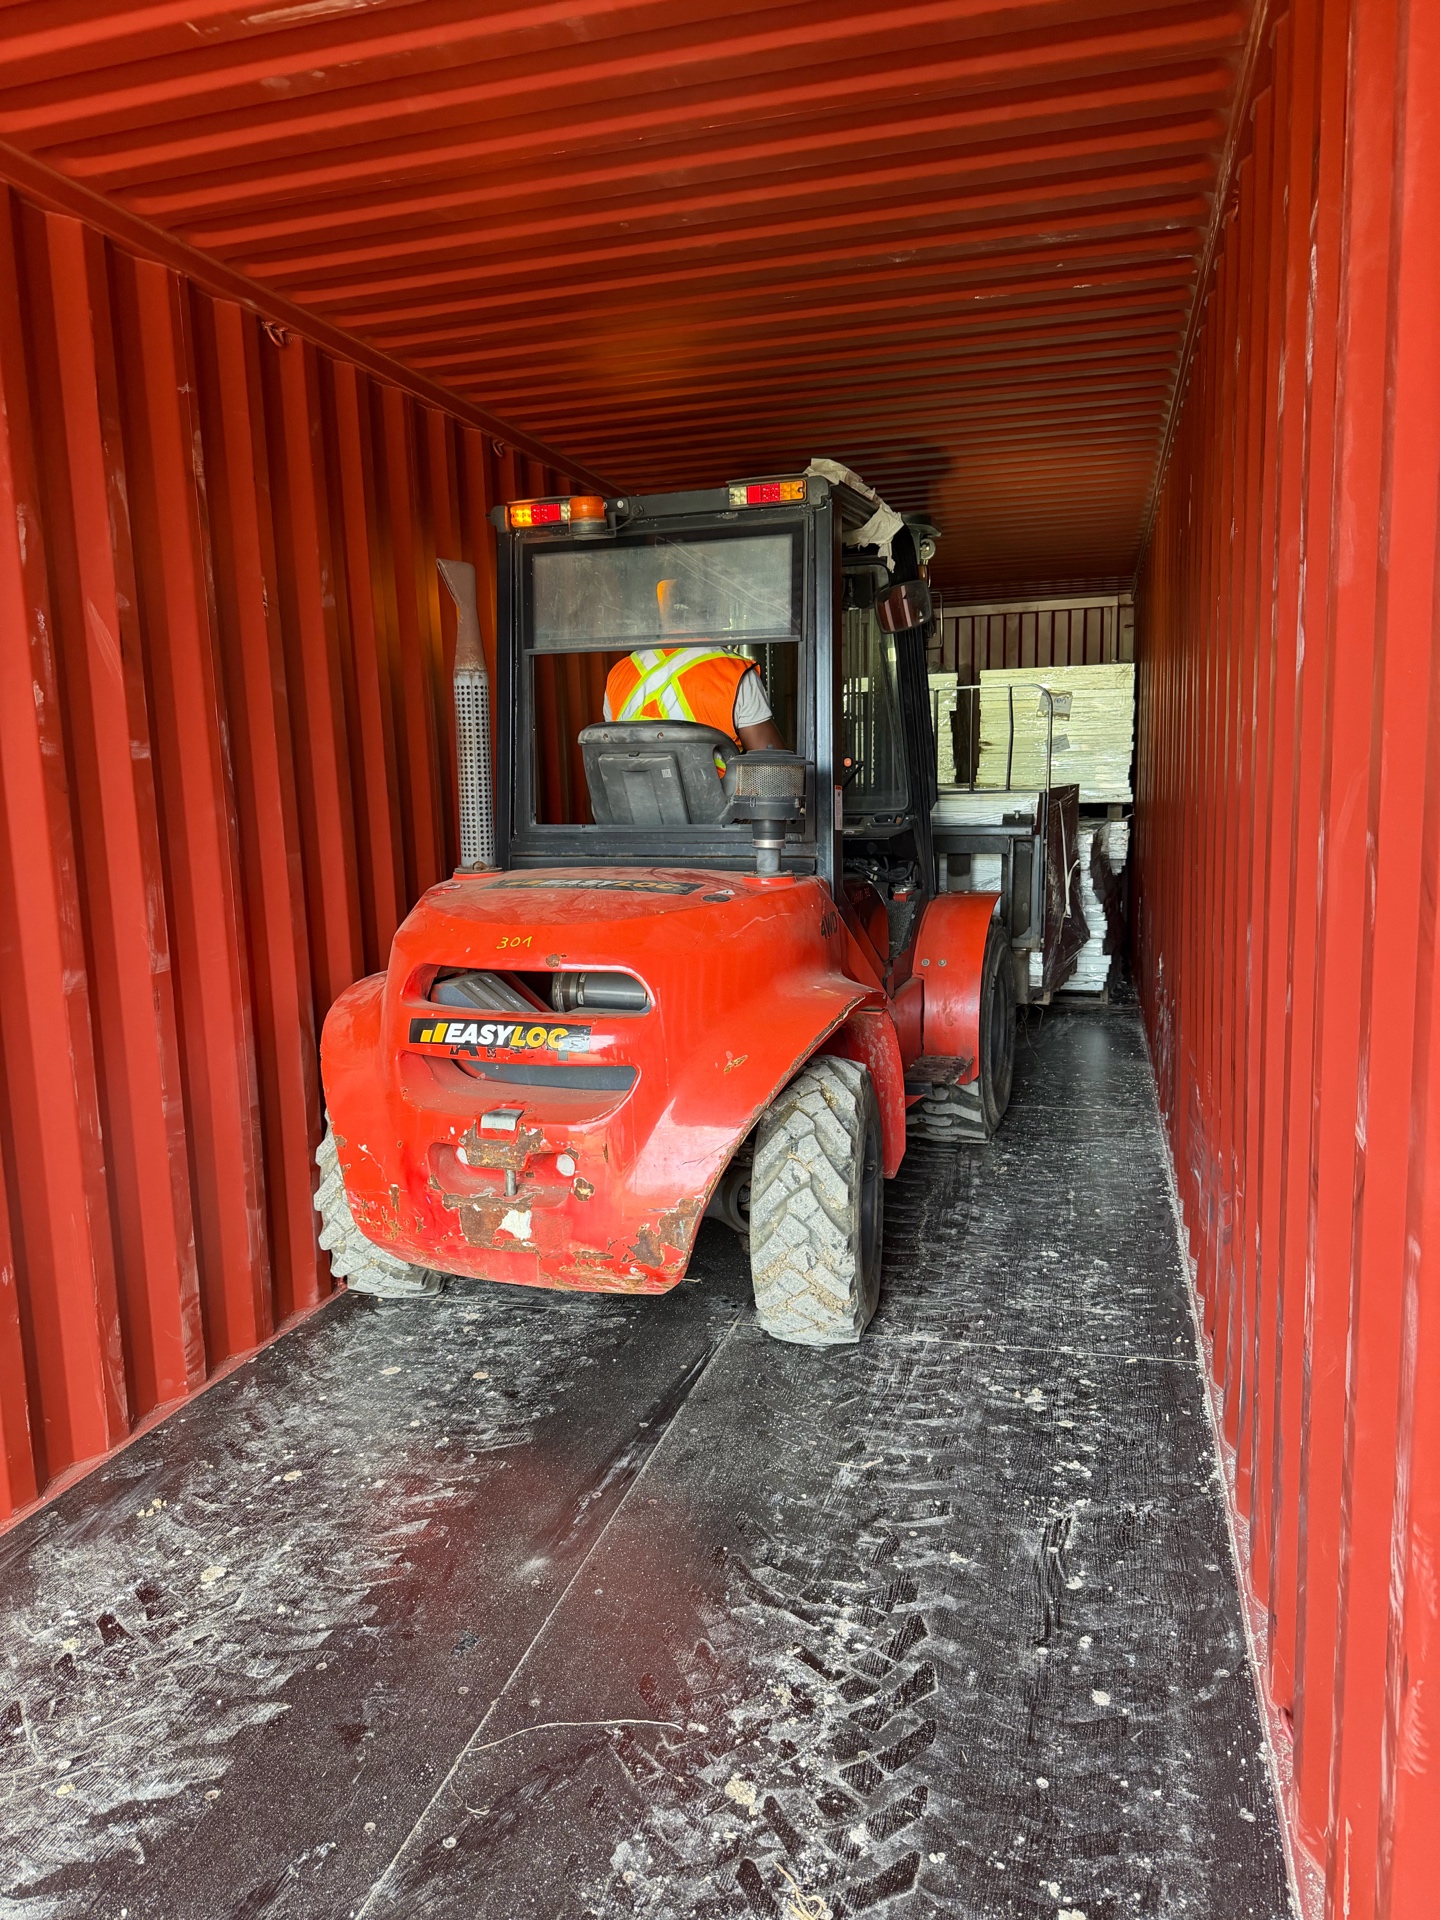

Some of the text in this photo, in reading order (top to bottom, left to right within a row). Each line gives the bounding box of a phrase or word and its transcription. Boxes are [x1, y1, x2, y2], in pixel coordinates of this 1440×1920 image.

[540, 880, 680, 889] EASYLOC
[820, 911, 838, 939] 4WD
[496, 936, 532, 949] 301
[444, 1023, 570, 1049] EASYLOC
